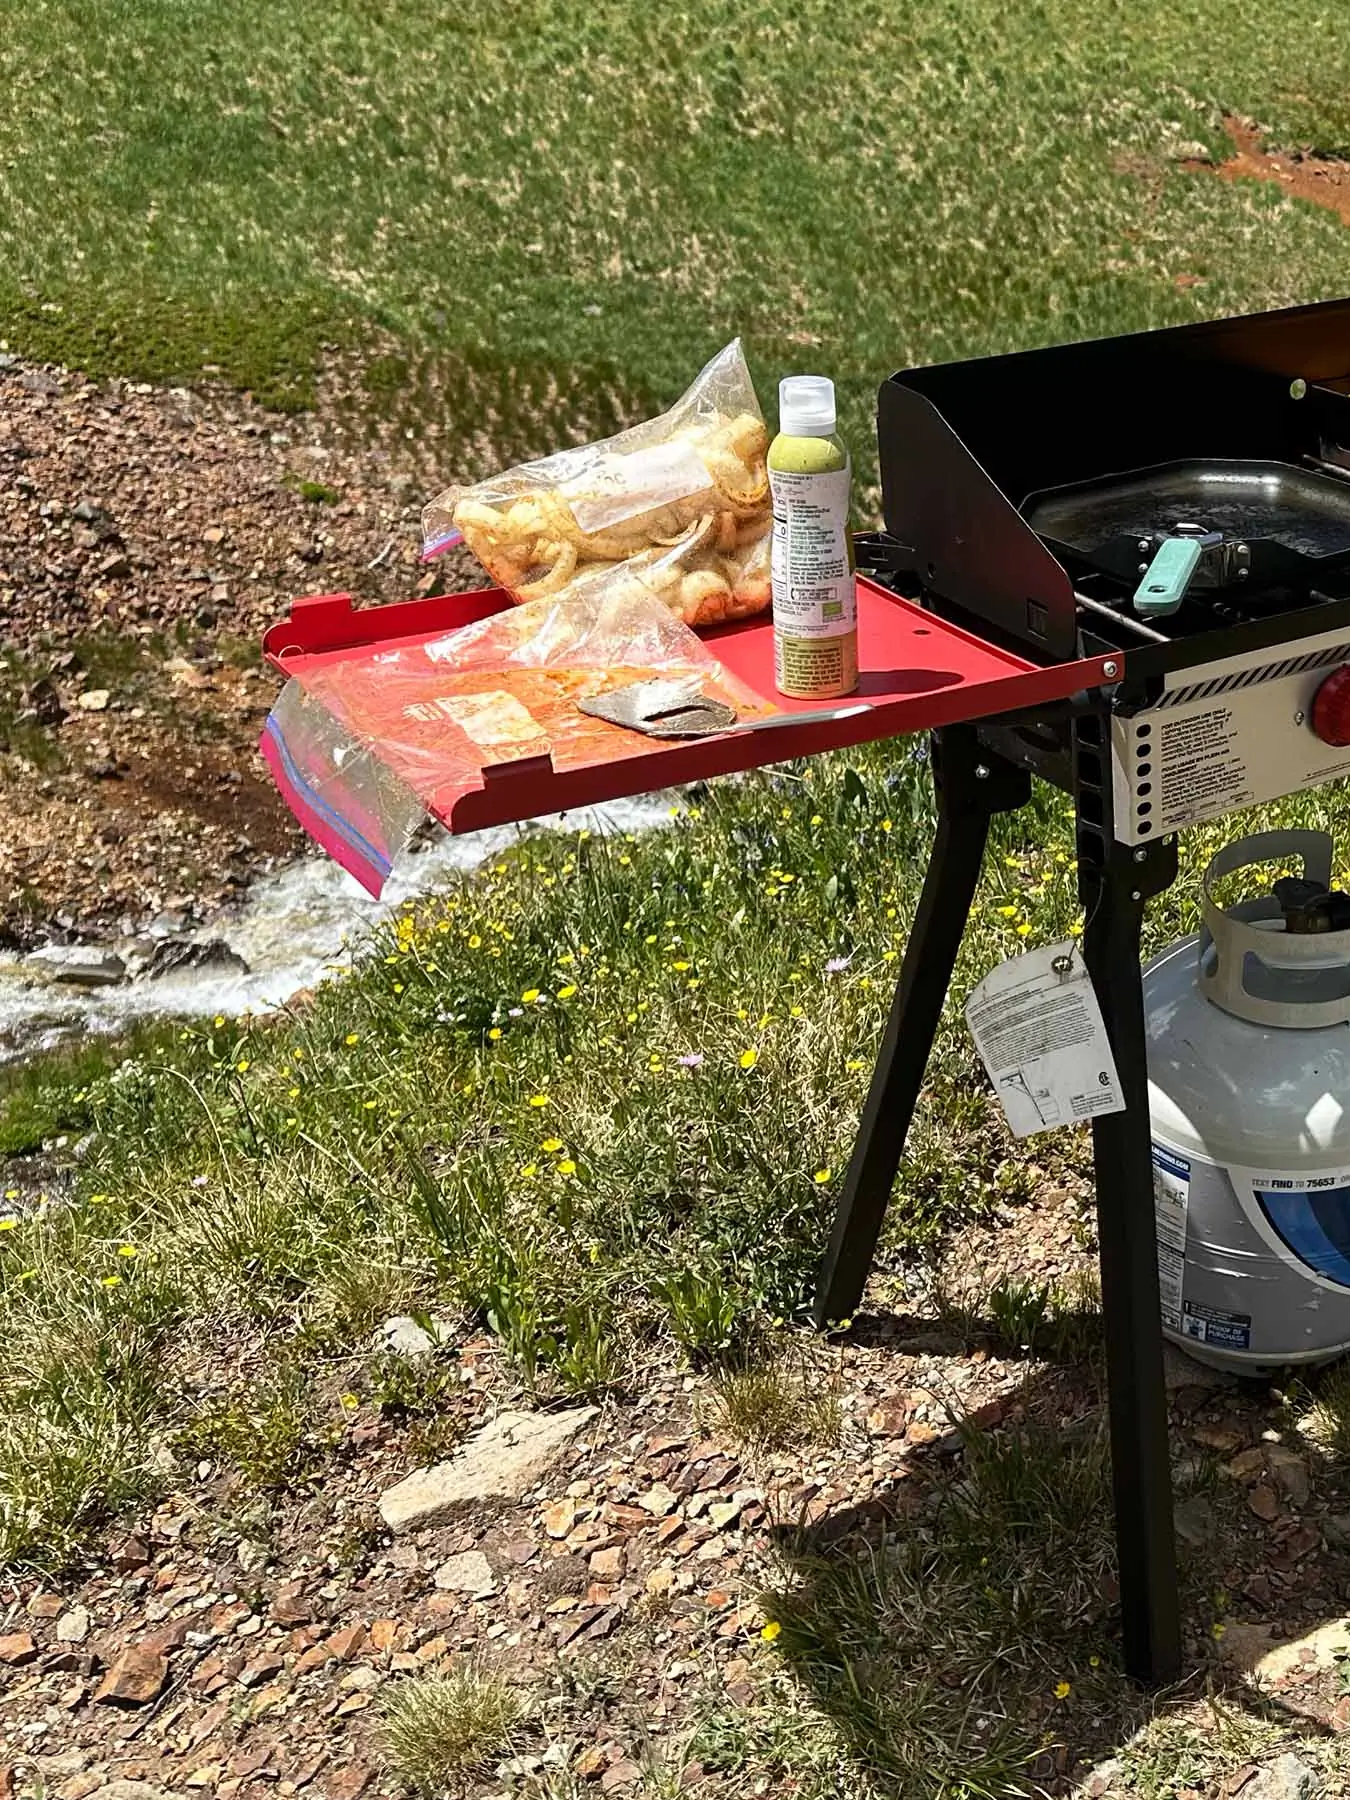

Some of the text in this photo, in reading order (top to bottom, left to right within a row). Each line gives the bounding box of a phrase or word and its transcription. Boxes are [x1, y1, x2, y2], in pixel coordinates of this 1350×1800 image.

[1252, 1178, 1269, 1187] TEXT
[1271, 1179, 1293, 1188] FIND
[1295, 1180, 1304, 1188] TO
[1306, 1177, 1335, 1188] 75653
